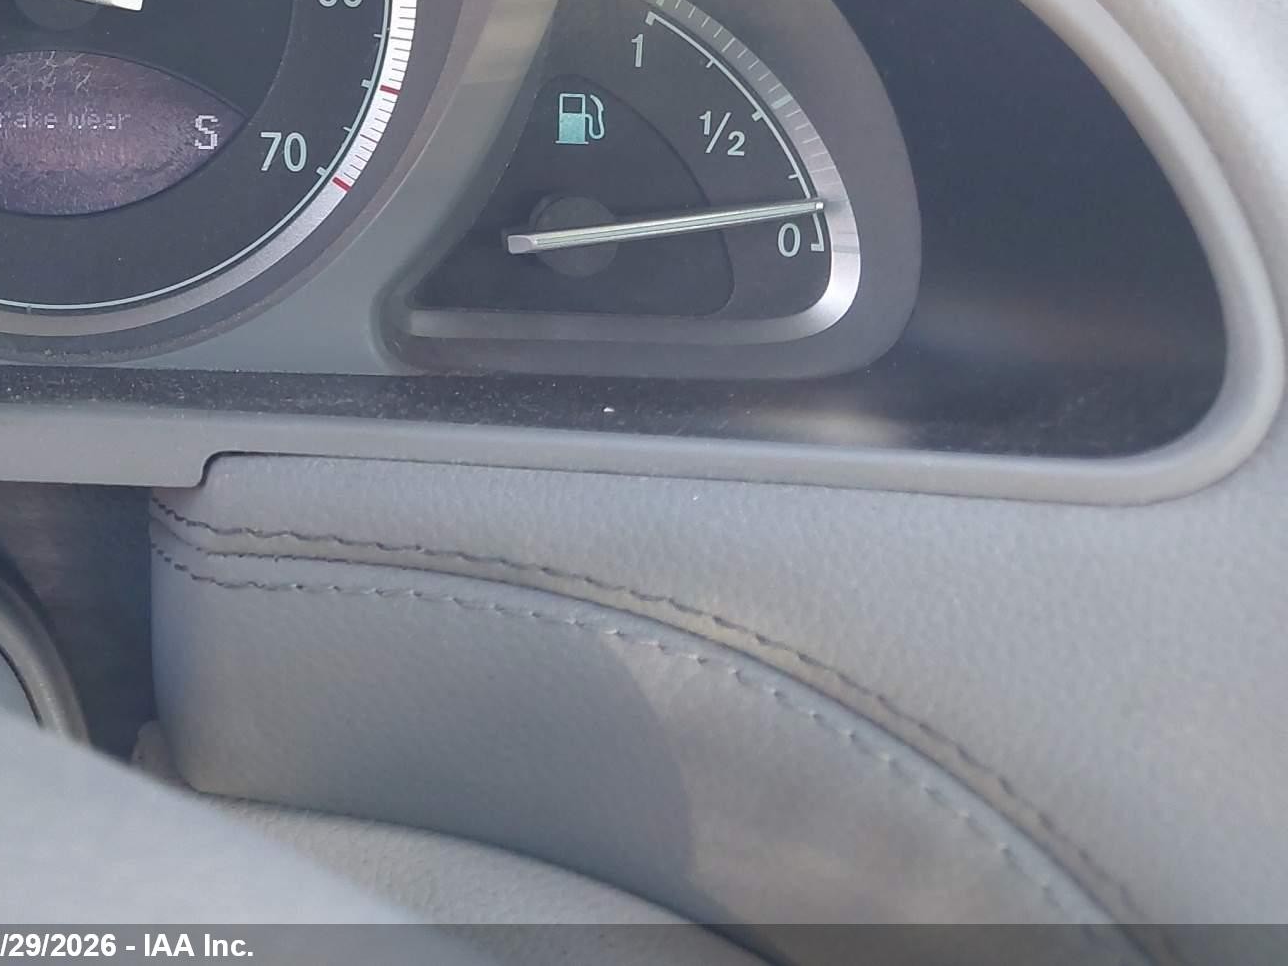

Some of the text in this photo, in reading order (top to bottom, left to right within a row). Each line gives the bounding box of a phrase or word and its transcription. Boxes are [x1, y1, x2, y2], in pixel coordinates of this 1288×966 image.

[631, 33, 644, 68] 1
[194, 114, 219, 150] S
[699, 110, 746, 156] 1/2
[260, 131, 307, 172] 70
[777, 222, 801, 258] 0
